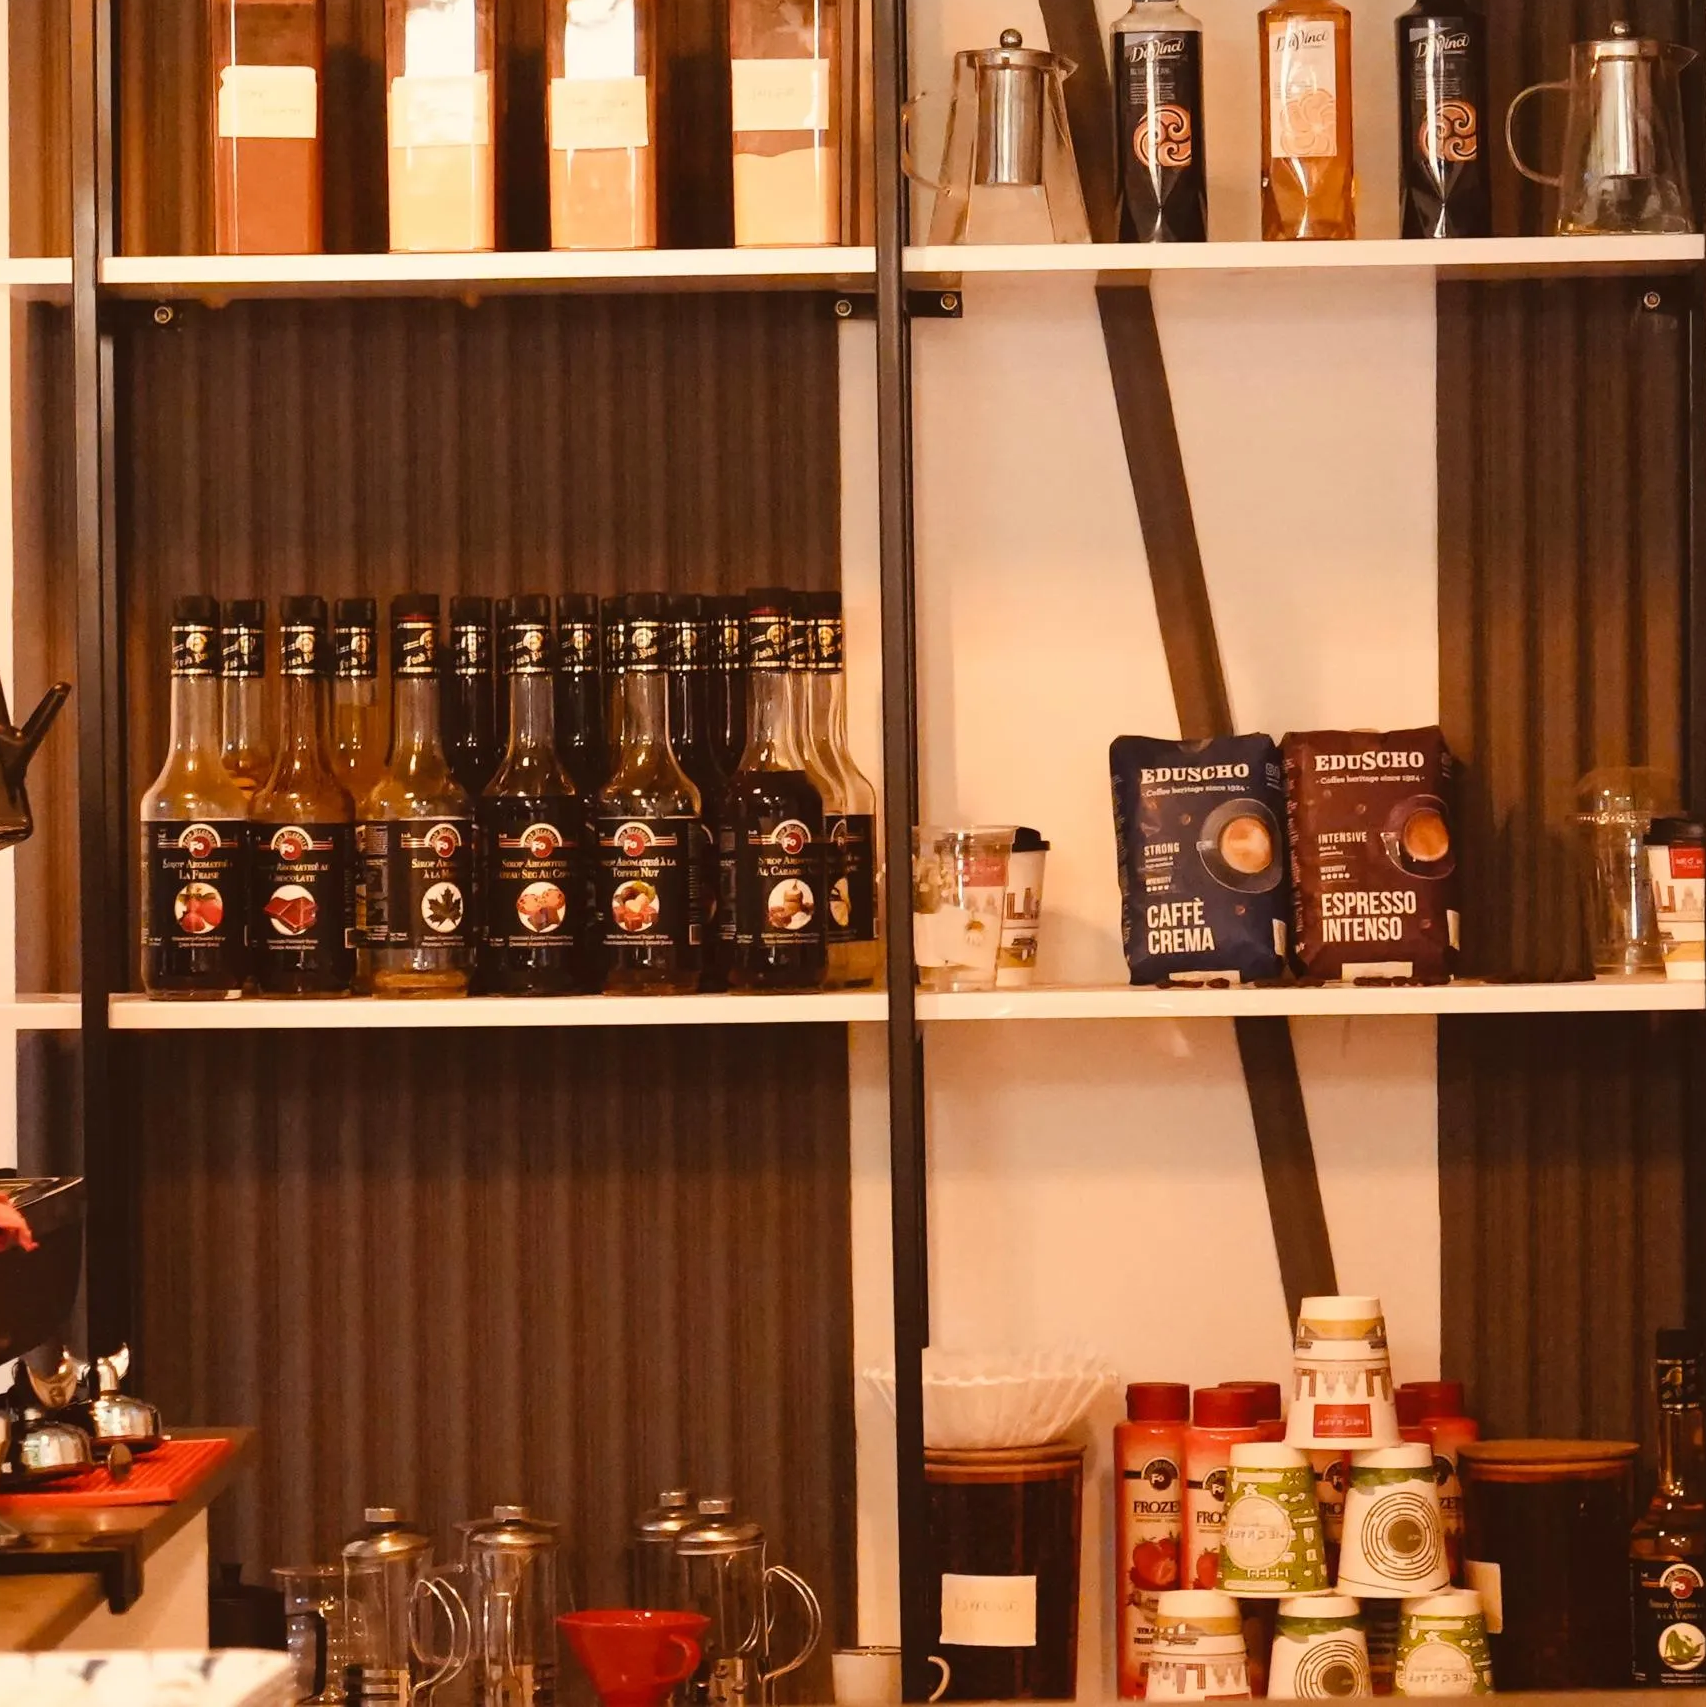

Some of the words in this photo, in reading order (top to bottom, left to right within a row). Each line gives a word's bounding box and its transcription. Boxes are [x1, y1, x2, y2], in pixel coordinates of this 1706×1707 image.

[1314, 751, 1425, 771] EDUSCHO
[1140, 763, 1250, 785] EDUSCHO
[1320, 776, 1345, 784] Coffee
[1346, 775, 1379, 783] heritage
[1146, 788, 1170, 797] Coffee
[1173, 786, 1204, 794] heritage
[1318, 832, 1367, 844] INTENSIVE
[1144, 842, 1180, 856] STRONG
[640, 867, 660, 878] NUT
[1321, 891, 1417, 917] ESPRESSO
[1147, 898, 1205, 929] CAFFÈ
[1322, 916, 1403, 943] INTENSO
[1147, 925, 1215, 955] CREMA
[1134, 1500, 1181, 1513] FROZE
